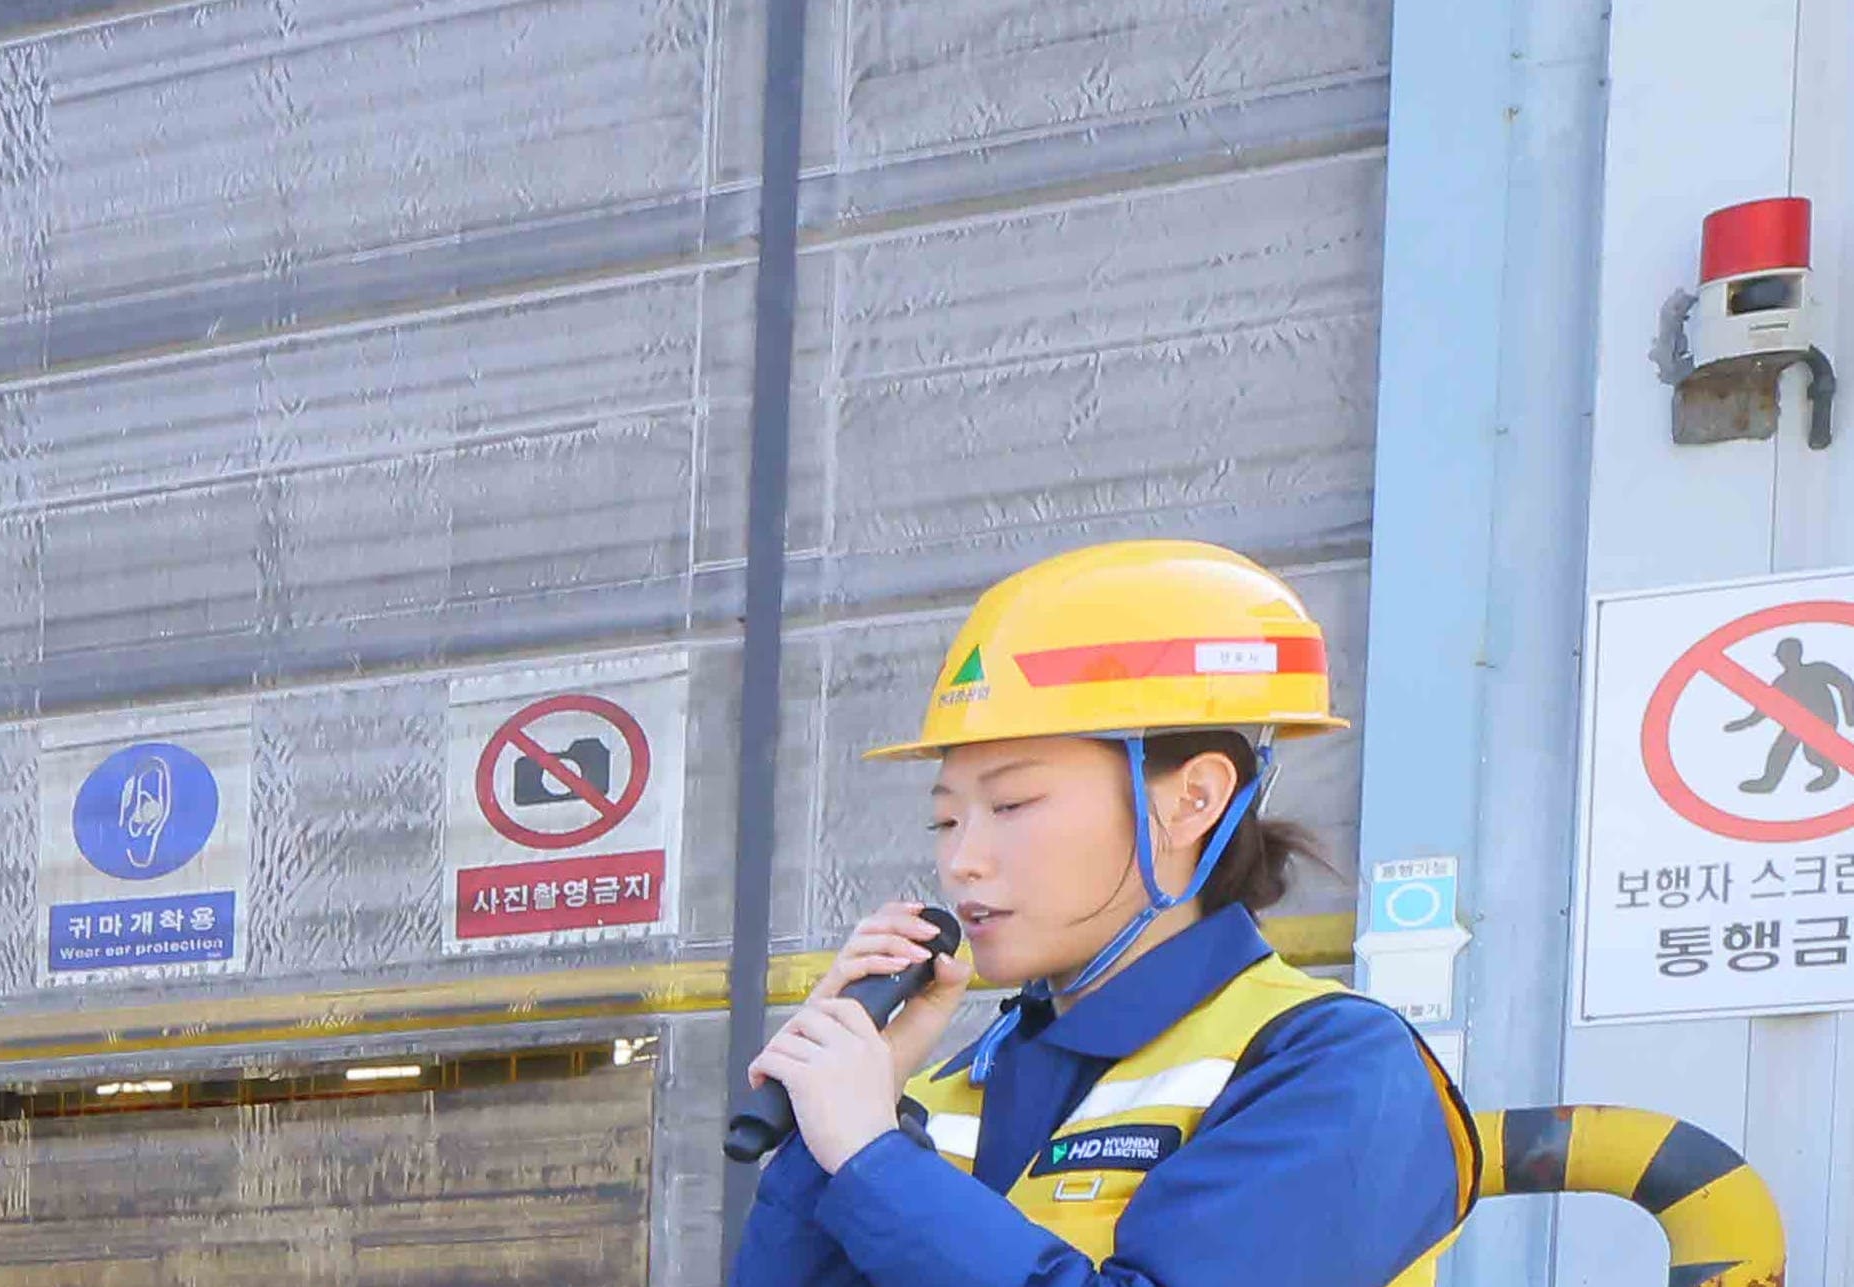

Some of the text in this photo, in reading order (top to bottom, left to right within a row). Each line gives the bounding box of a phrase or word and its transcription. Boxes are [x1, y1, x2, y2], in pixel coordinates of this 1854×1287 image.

[473, 871, 650, 916] 사진촬영금지
[1615, 861, 1734, 909] 보행자
[69, 906, 216, 940] 귀마개착용
[60, 948, 101, 960] Wear
[105, 946, 132, 957] ear
[136, 938, 223, 957] protection
[1068, 1138, 1101, 1160] HD
[1102, 1147, 1158, 1159] ELECTRIC
[1104, 1136, 1159, 1150] HYUNDAI
